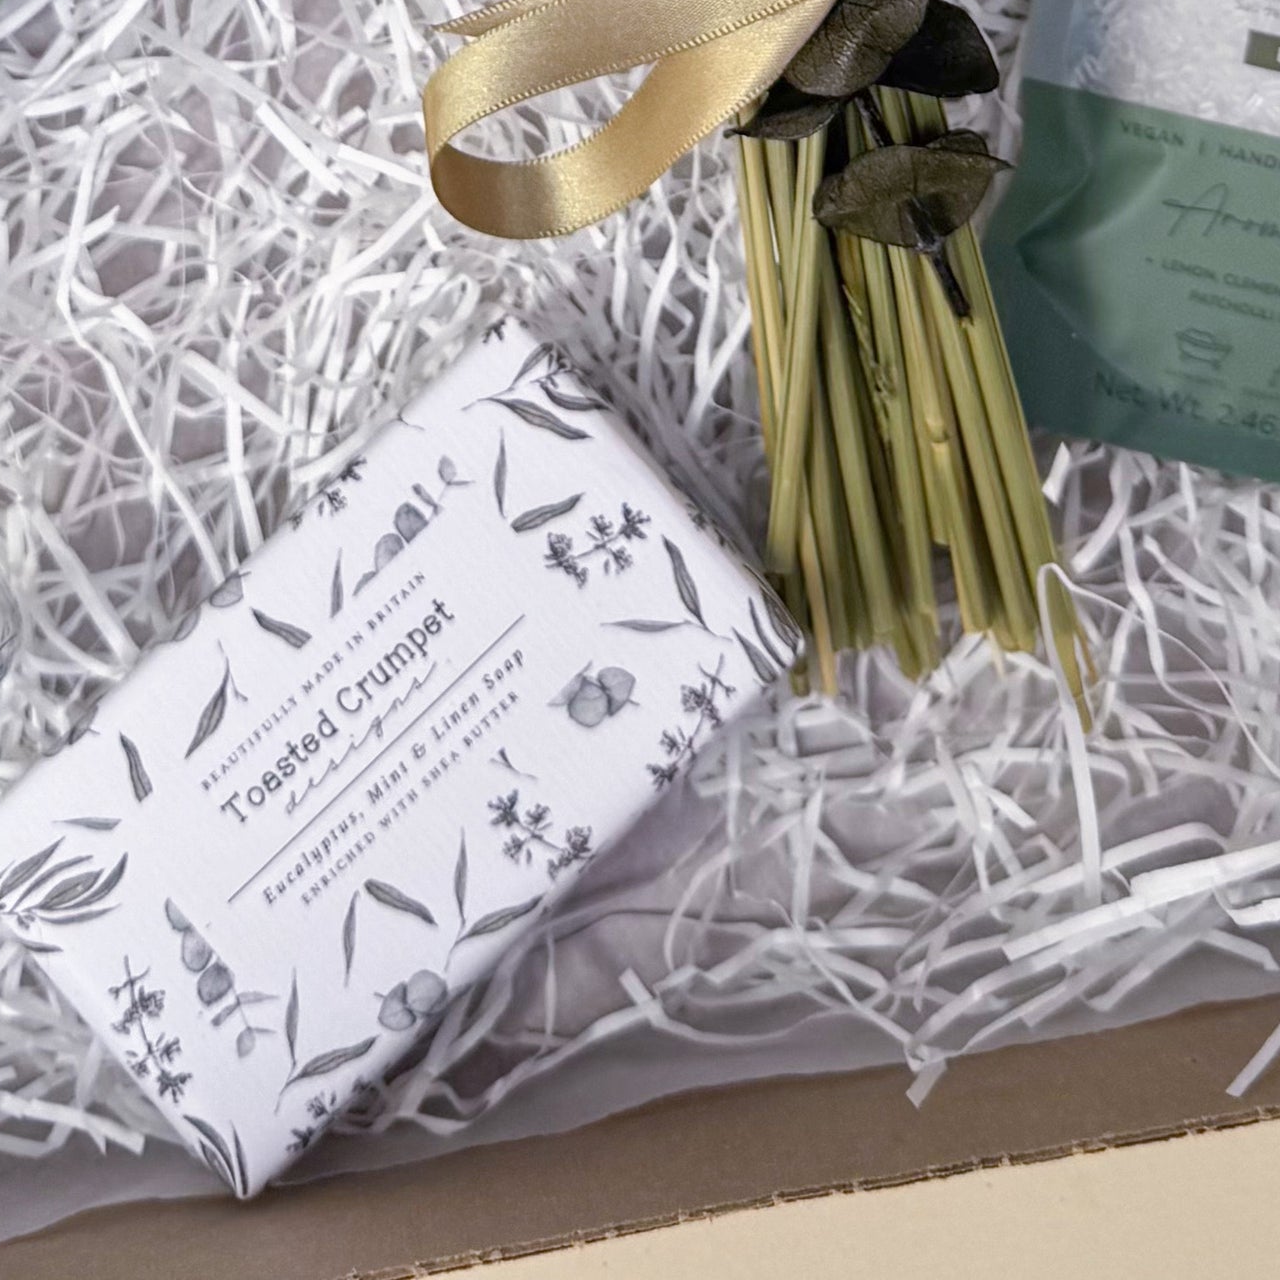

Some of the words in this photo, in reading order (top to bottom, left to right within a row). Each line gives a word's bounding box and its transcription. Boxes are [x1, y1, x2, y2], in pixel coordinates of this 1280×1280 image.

[1120, 119, 1183, 147] VEGAN
[200, 696, 298, 791] BEAUTIFULLY
[302, 651, 344, 695] MADE
[345, 630, 365, 651] IN
[366, 571, 426, 631] BRITAIN
[220, 708, 338, 823] Toasted
[335, 597, 456, 714] Crumpet
[263, 810, 366, 905] Eucalyptus,
[366, 760, 408, 804] Mint
[412, 742, 428, 760] &
[430, 691, 480, 742] Linen
[481, 647, 525, 691] Soap
[285, 661, 438, 816] designs
[300, 830, 376, 906] ENRICHED
[378, 788, 419, 830] WITH
[420, 749, 460, 788] SHEA
[461, 690, 519, 749] BUTTER
